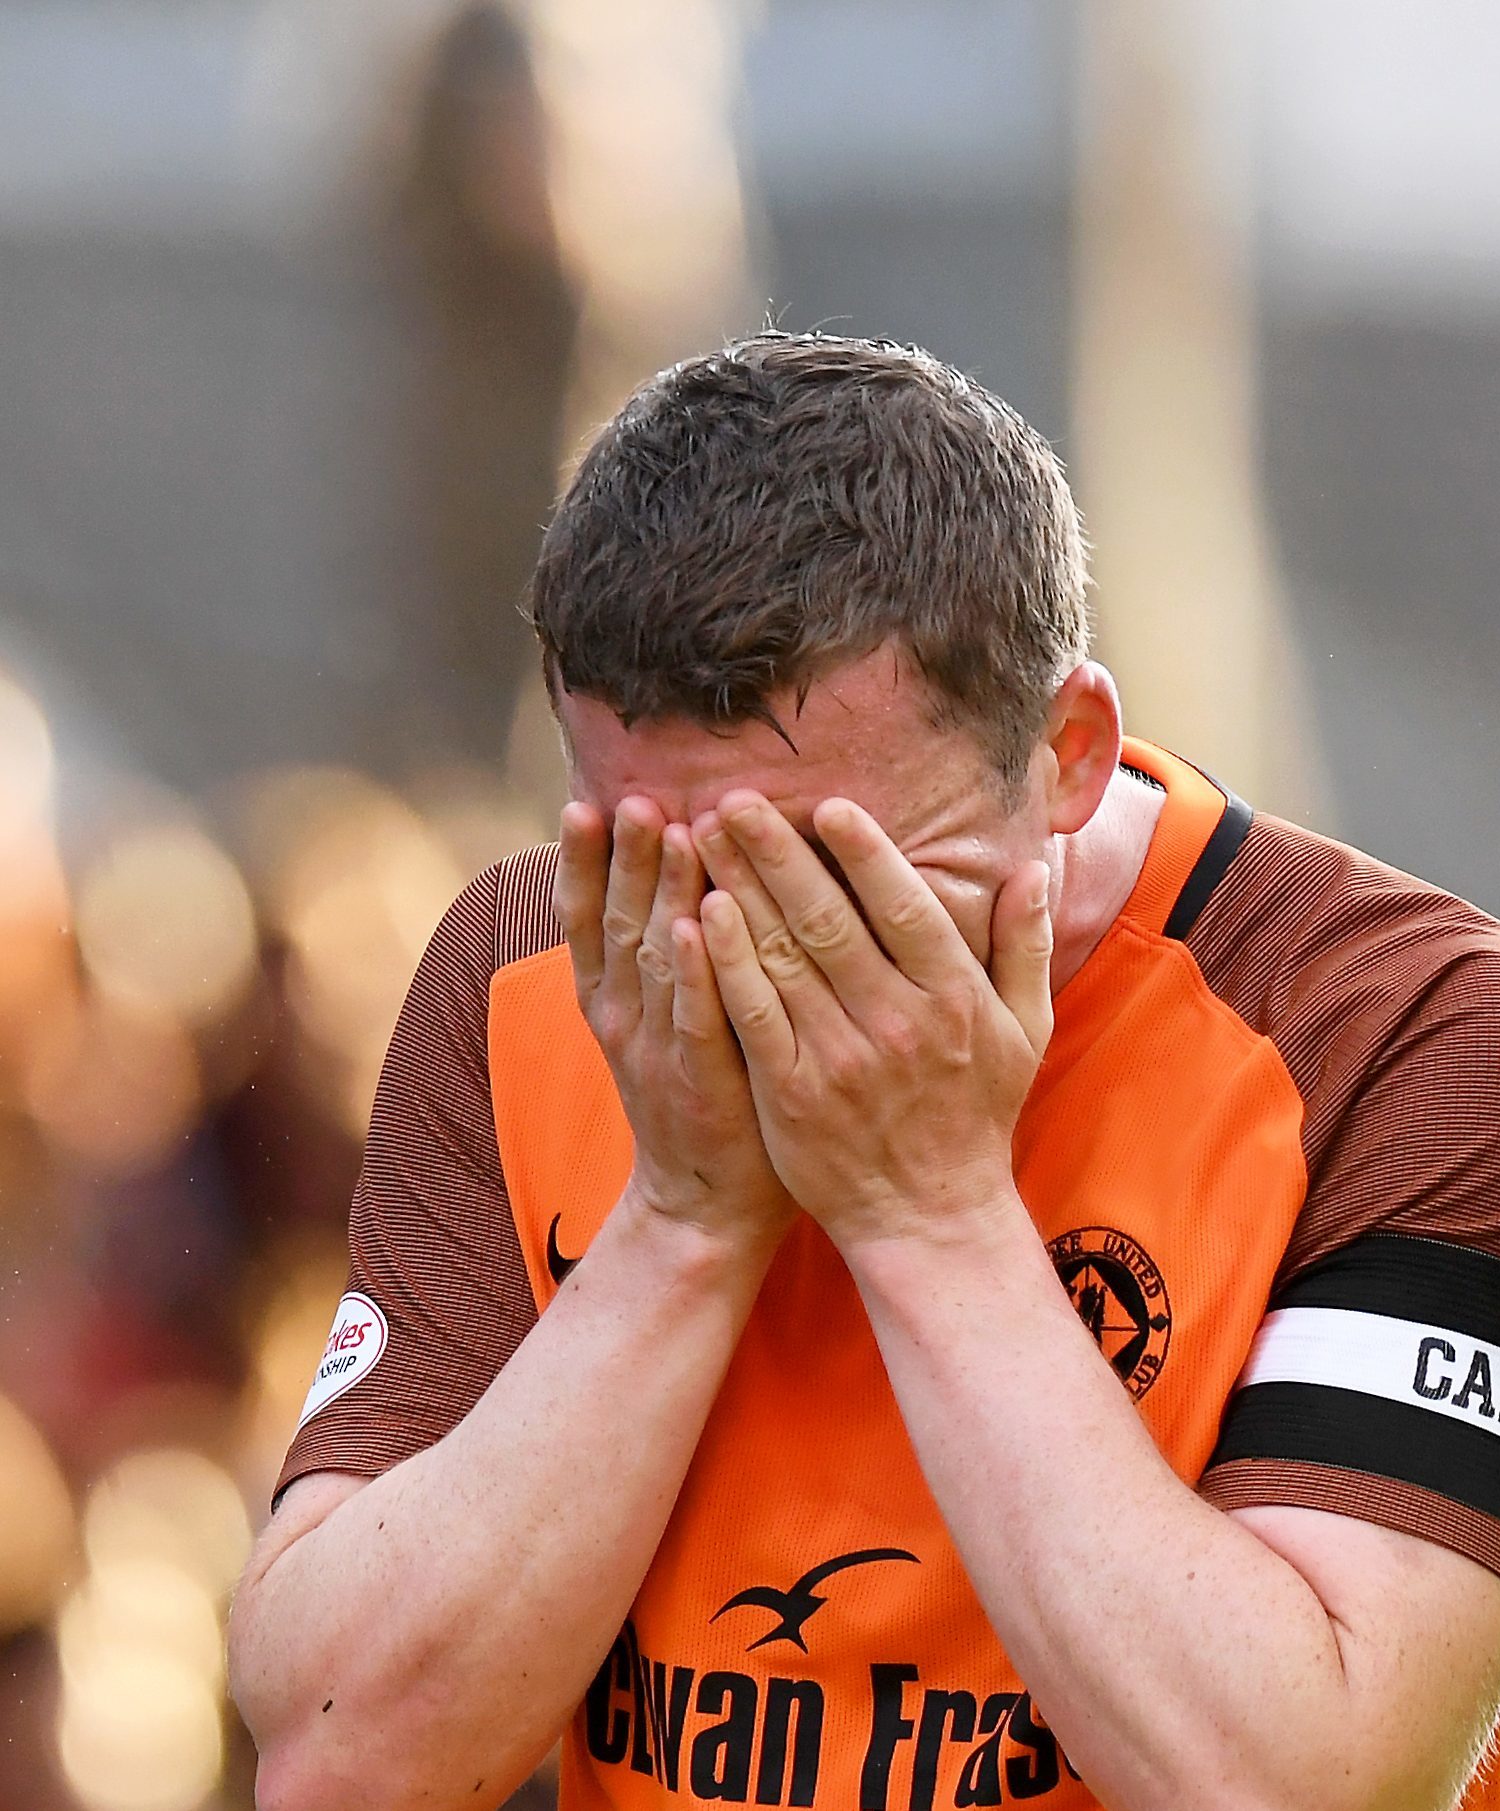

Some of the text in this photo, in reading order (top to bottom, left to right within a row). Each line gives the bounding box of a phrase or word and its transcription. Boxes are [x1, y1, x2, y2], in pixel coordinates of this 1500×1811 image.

[1103, 1232, 1162, 1299] UNITED
[1126, 1353, 1161, 1397] LUB
[858, 1662, 1083, 1811] Fras
